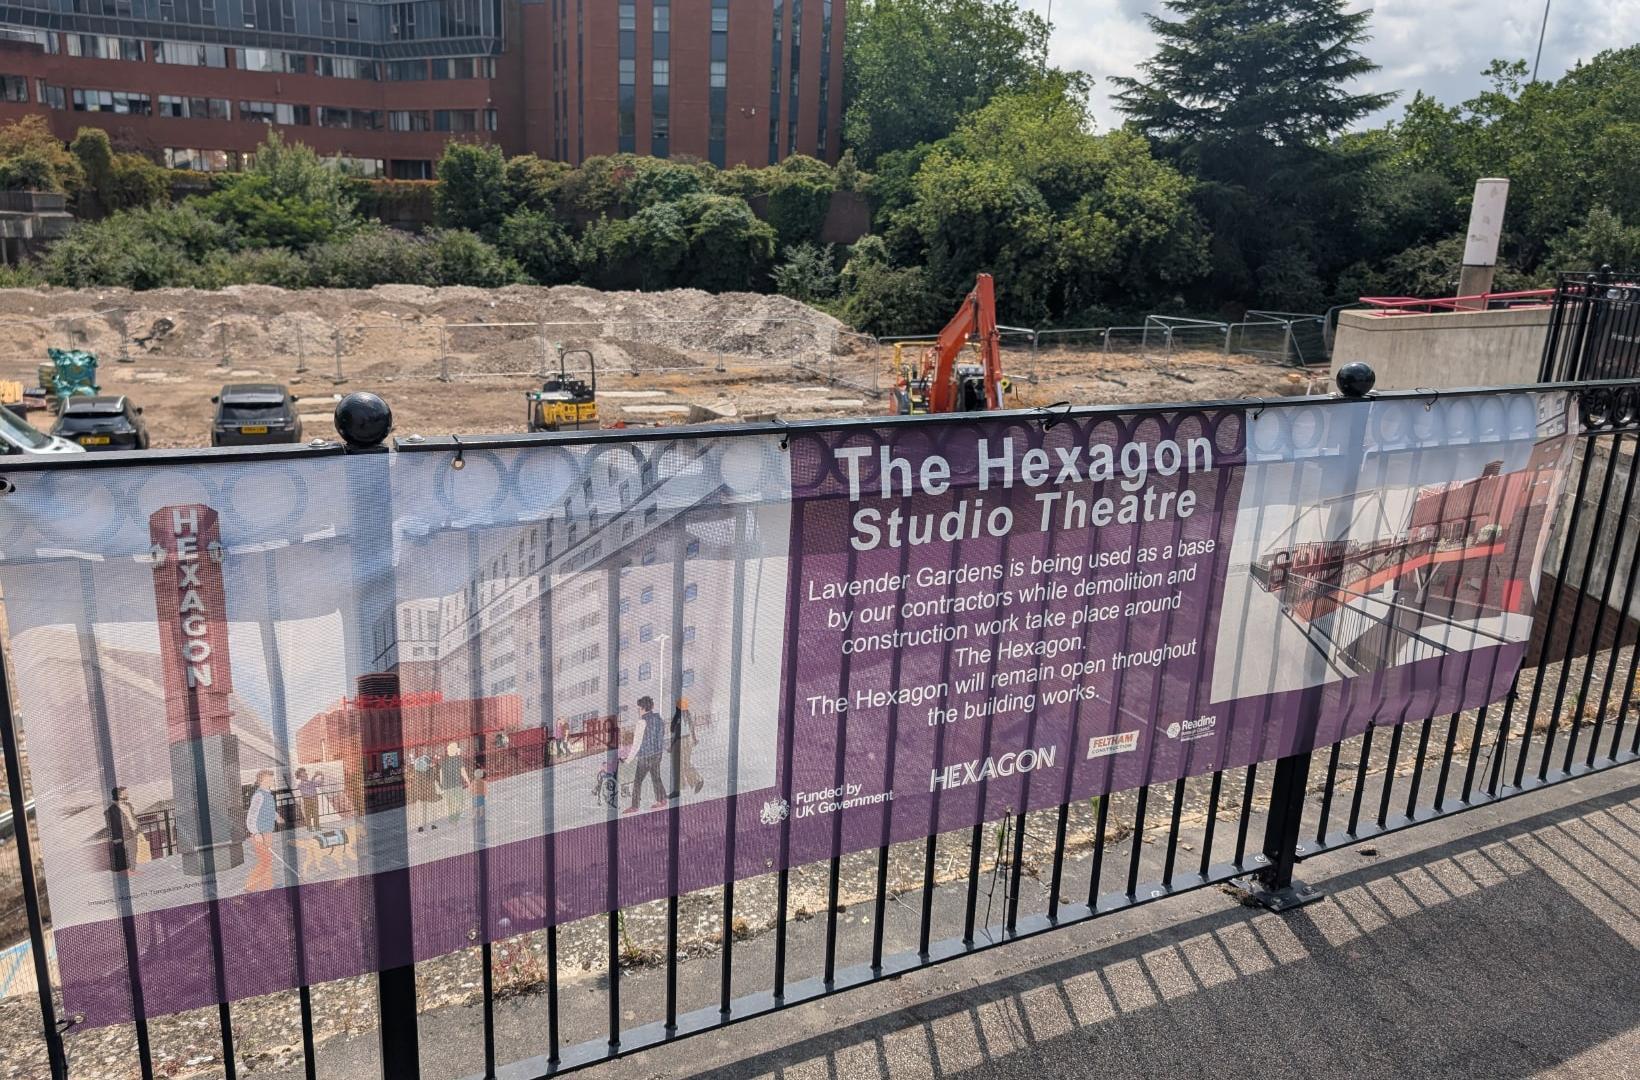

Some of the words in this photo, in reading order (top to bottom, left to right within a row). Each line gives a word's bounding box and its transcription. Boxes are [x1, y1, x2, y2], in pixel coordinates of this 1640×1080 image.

[834, 445, 951, 502] The
[978, 435, 1213, 492] Hexagon
[850, 500, 1014, 551] Studio
[1034, 487, 1197, 532] Theatre
[808, 572, 910, 601] Lavender
[916, 563, 1004, 588] Gardens
[1009, 558, 1025, 578] is
[1030, 554, 1083, 575] being
[1088, 545, 1132, 569] used
[1136, 547, 1158, 563] as
[1162, 545, 1173, 560] a
[1177, 538, 1216, 558] base
[172, 509, 212, 688] HEXAGON
[827, 608, 854, 632] by
[860, 604, 896, 624] our
[901, 590, 1013, 619] contractors
[1018, 582, 1068, 604] while
[1073, 570, 1163, 598] demolition
[1167, 563, 1197, 584] and
[841, 623, 968, 655] construction
[974, 613, 1019, 638] work
[1025, 610, 1066, 630] take
[1071, 604, 1120, 629] place
[1124, 590, 1182, 617] around
[806, 695, 848, 717] The
[856, 681, 949, 711] Hexagon
[955, 672, 985, 695] will
[991, 663, 1055, 689] remain
[1060, 658, 1106, 681] open
[1111, 637, 1198, 671] throughout
[954, 646, 992, 668] The
[998, 636, 1087, 661] Hexagon.
[927, 706, 959, 727] the
[964, 692, 1037, 721] building
[1042, 683, 1100, 706] works.
[1182, 715, 1216, 730] Reading
[1093, 734, 1134, 748] FELTHAM
[796, 784, 844, 805] Funded
[846, 783, 862, 796] by
[929, 745, 1057, 793] HEXAGON
[795, 804, 815, 819] UK
[818, 789, 894, 814] Government
